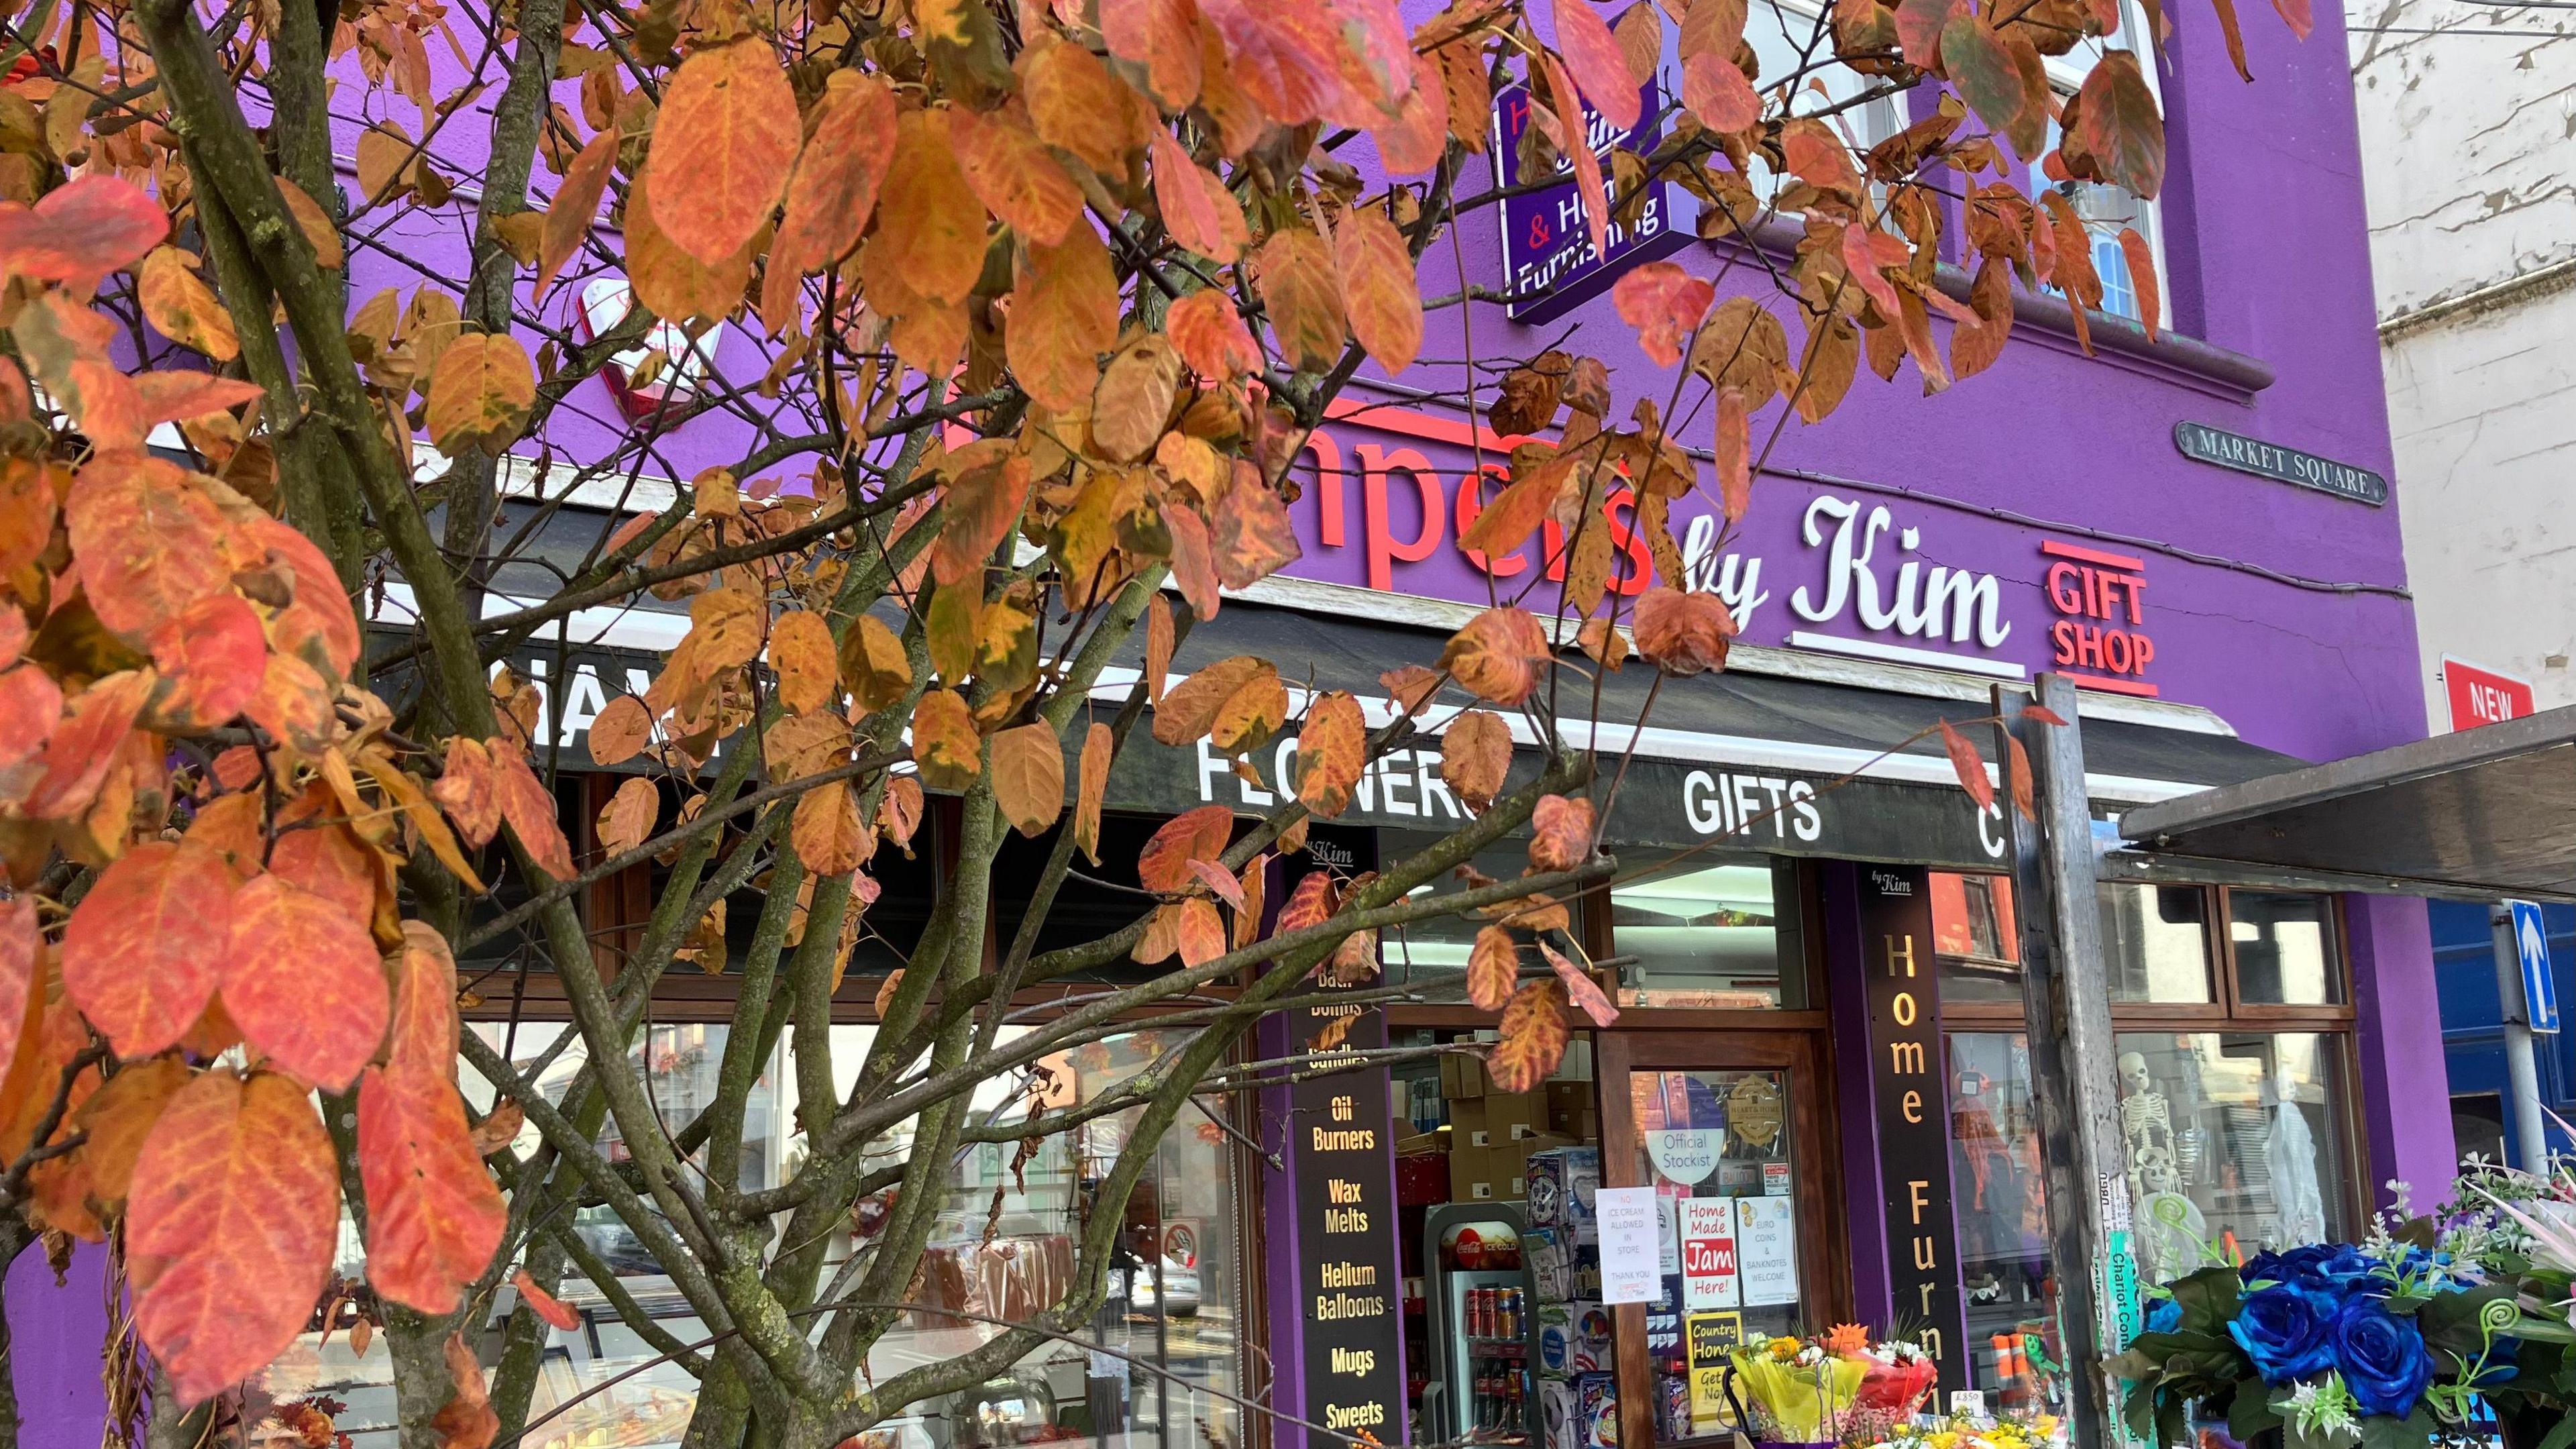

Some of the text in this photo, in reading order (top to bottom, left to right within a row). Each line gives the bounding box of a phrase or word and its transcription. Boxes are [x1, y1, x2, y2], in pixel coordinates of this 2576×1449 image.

[1529, 214, 1550, 250] &
[2199, 429, 2370, 495] MARKET SQUARE
[1683, 515, 1769, 636] by
[1790, 495, 2010, 648] Kim
[2046, 561, 2147, 625] GIFT
[2052, 620, 2155, 676] SHOP
[2470, 682, 2512, 722] NEW
[1684, 769, 1821, 841] GIFTS
[1313, 841, 1353, 863] Kim
[1872, 871, 1911, 893] by Kim
[1884, 934, 1924, 1124] Home
[1332, 1096, 1352, 1121] Oil
[1313, 1127, 1375, 1151] Burners
[1664, 1134, 1707, 1148] Official
[1663, 1152, 1711, 1169] Stockist
[1328, 1179, 1362, 1203] Wax
[1621, 1195, 1631, 1203] NO
[1325, 1208, 1368, 1234] Melts
[1609, 1208, 1644, 1218] ICE CREAM
[1688, 1204, 1725, 1218] Home
[1611, 1220, 1644, 1230] ALLOWED
[1690, 1220, 1726, 1234] Made
[1756, 1221, 1774, 1229] EURO
[1497, 1243, 1516, 1251] COLD
[1755, 1234, 1776, 1242] COINS
[1617, 1246, 1640, 1254] STORE
[1687, 1241, 1733, 1271] Jam
[1746, 1258, 1787, 1269] BANKNOTES
[1322, 1263, 1376, 1289] Helium
[1611, 1272, 1634, 1281] THANK
[1695, 1279, 1729, 1295] Here!
[1752, 1272, 1785, 1282] WELCOME
[2113, 1253, 2127, 1307] Chariot
[1317, 1293, 1384, 1320] Balloons
[1693, 1324, 1736, 1339] Country
[1694, 1341, 1737, 1359] Hone
[1332, 1347, 1375, 1377] Mugs
[1701, 1372, 1721, 1385] Get
[1326, 1401, 1383, 1430] Sweets
